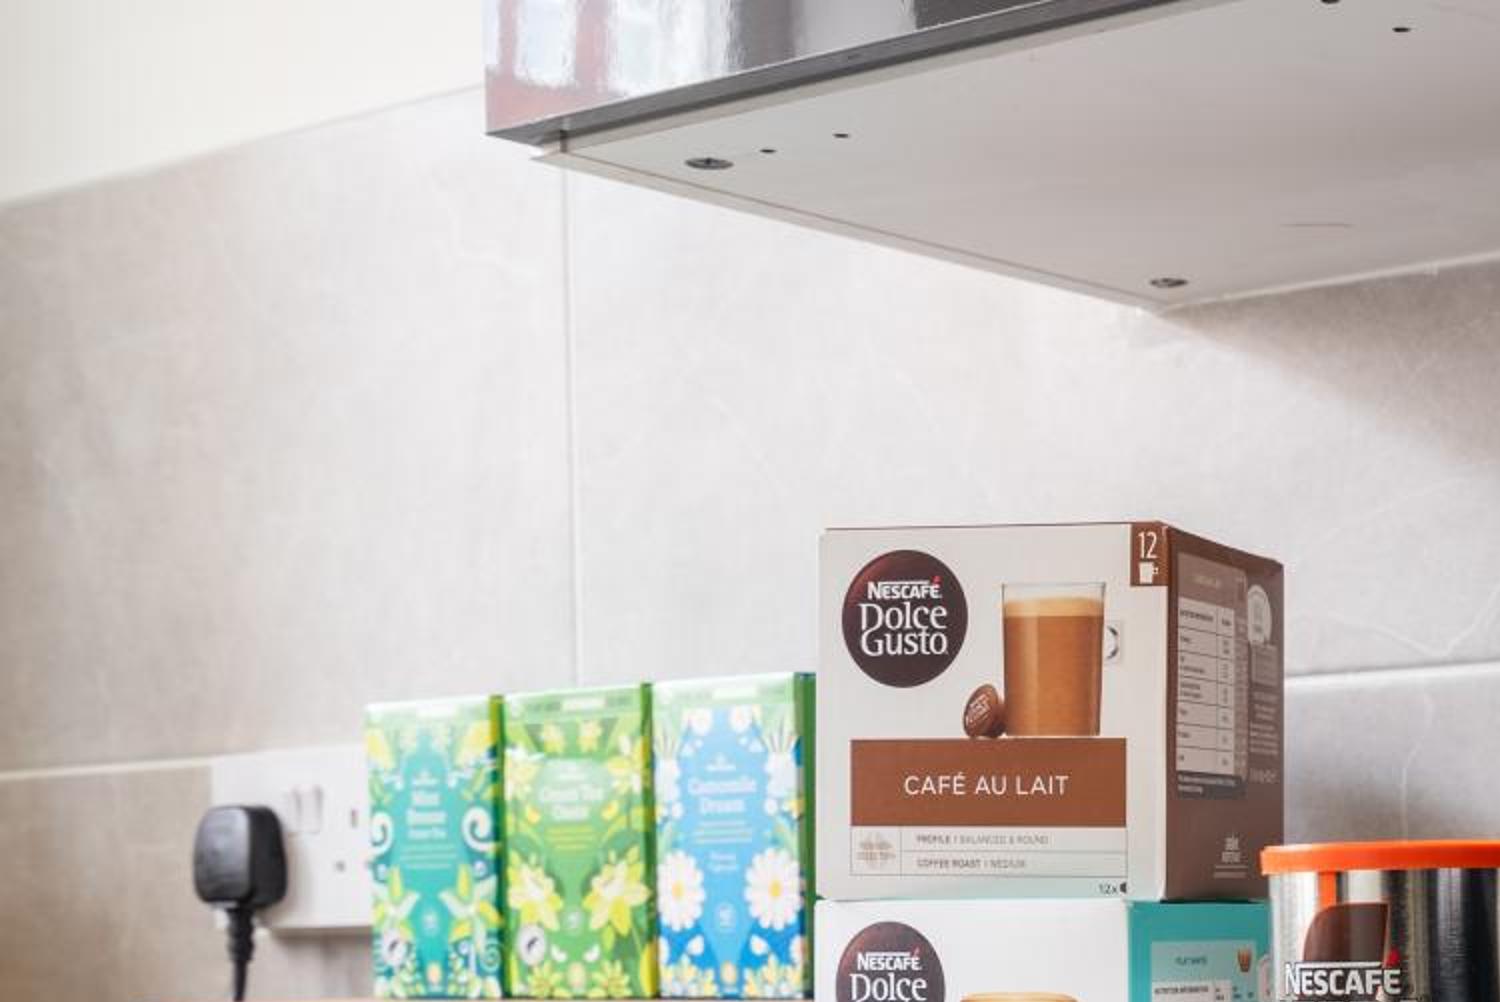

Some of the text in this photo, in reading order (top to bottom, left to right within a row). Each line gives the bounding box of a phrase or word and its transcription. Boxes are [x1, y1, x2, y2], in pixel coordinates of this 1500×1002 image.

[1138, 531, 1157, 558] 12
[867, 575, 942, 600] NESCAFÉ
[858, 601, 947, 631] Dolce
[861, 627, 948, 656] Gusto
[904, 771, 1069, 796] CAFÉ AU LAIT
[951, 859, 981, 869] ROAST
[857, 947, 922, 971] NESCAFÉ
[849, 972, 927, 1001] Dolce
